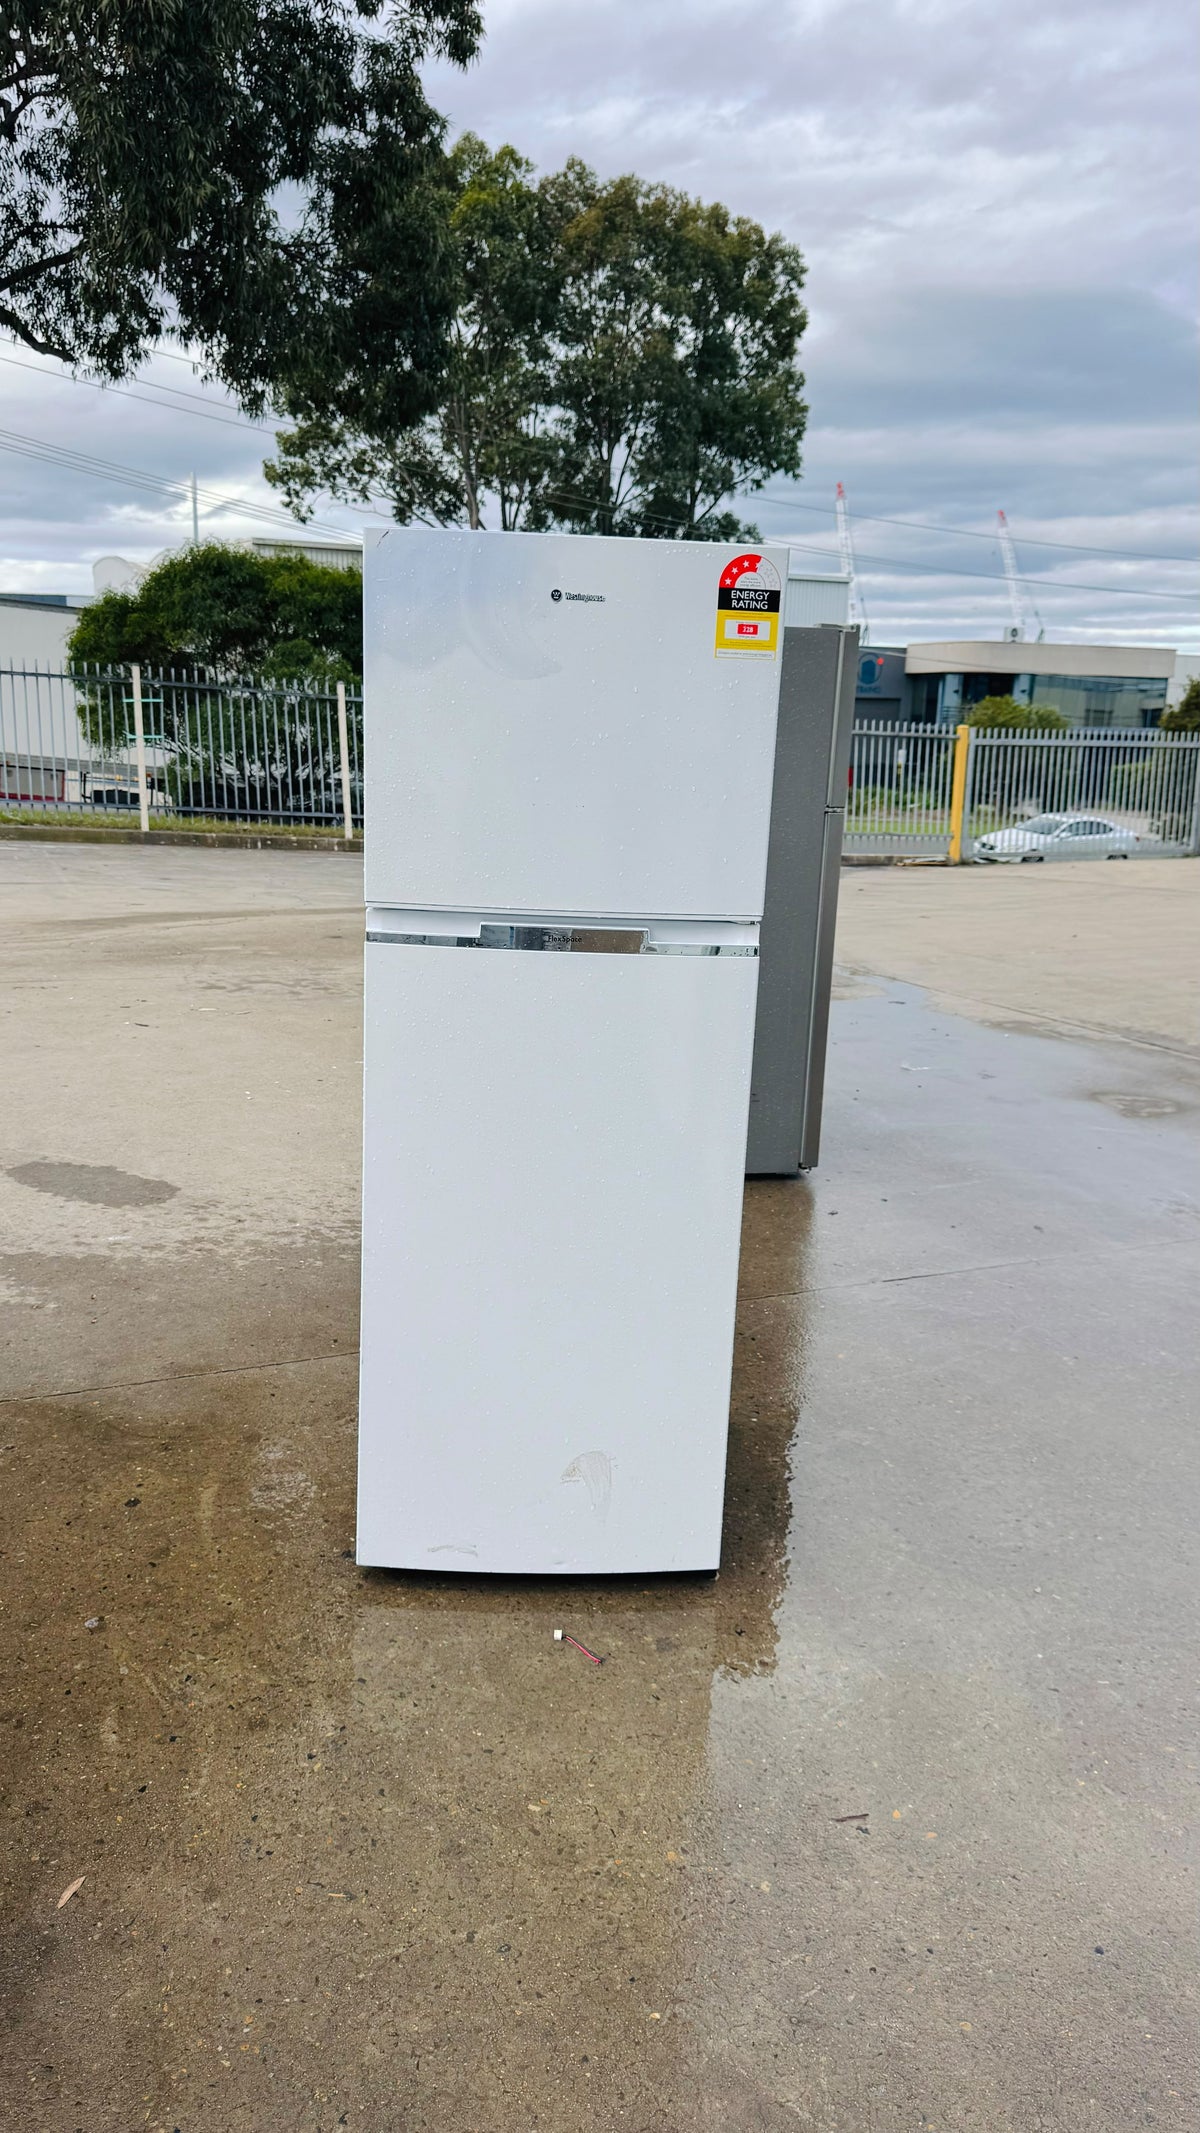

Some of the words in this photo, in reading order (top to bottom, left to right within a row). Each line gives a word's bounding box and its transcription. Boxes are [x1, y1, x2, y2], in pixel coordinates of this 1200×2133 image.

[731, 590, 770, 600] ENERGY
[731, 600, 769, 610] RATING
[548, 935, 583, 943] FlexSpace
